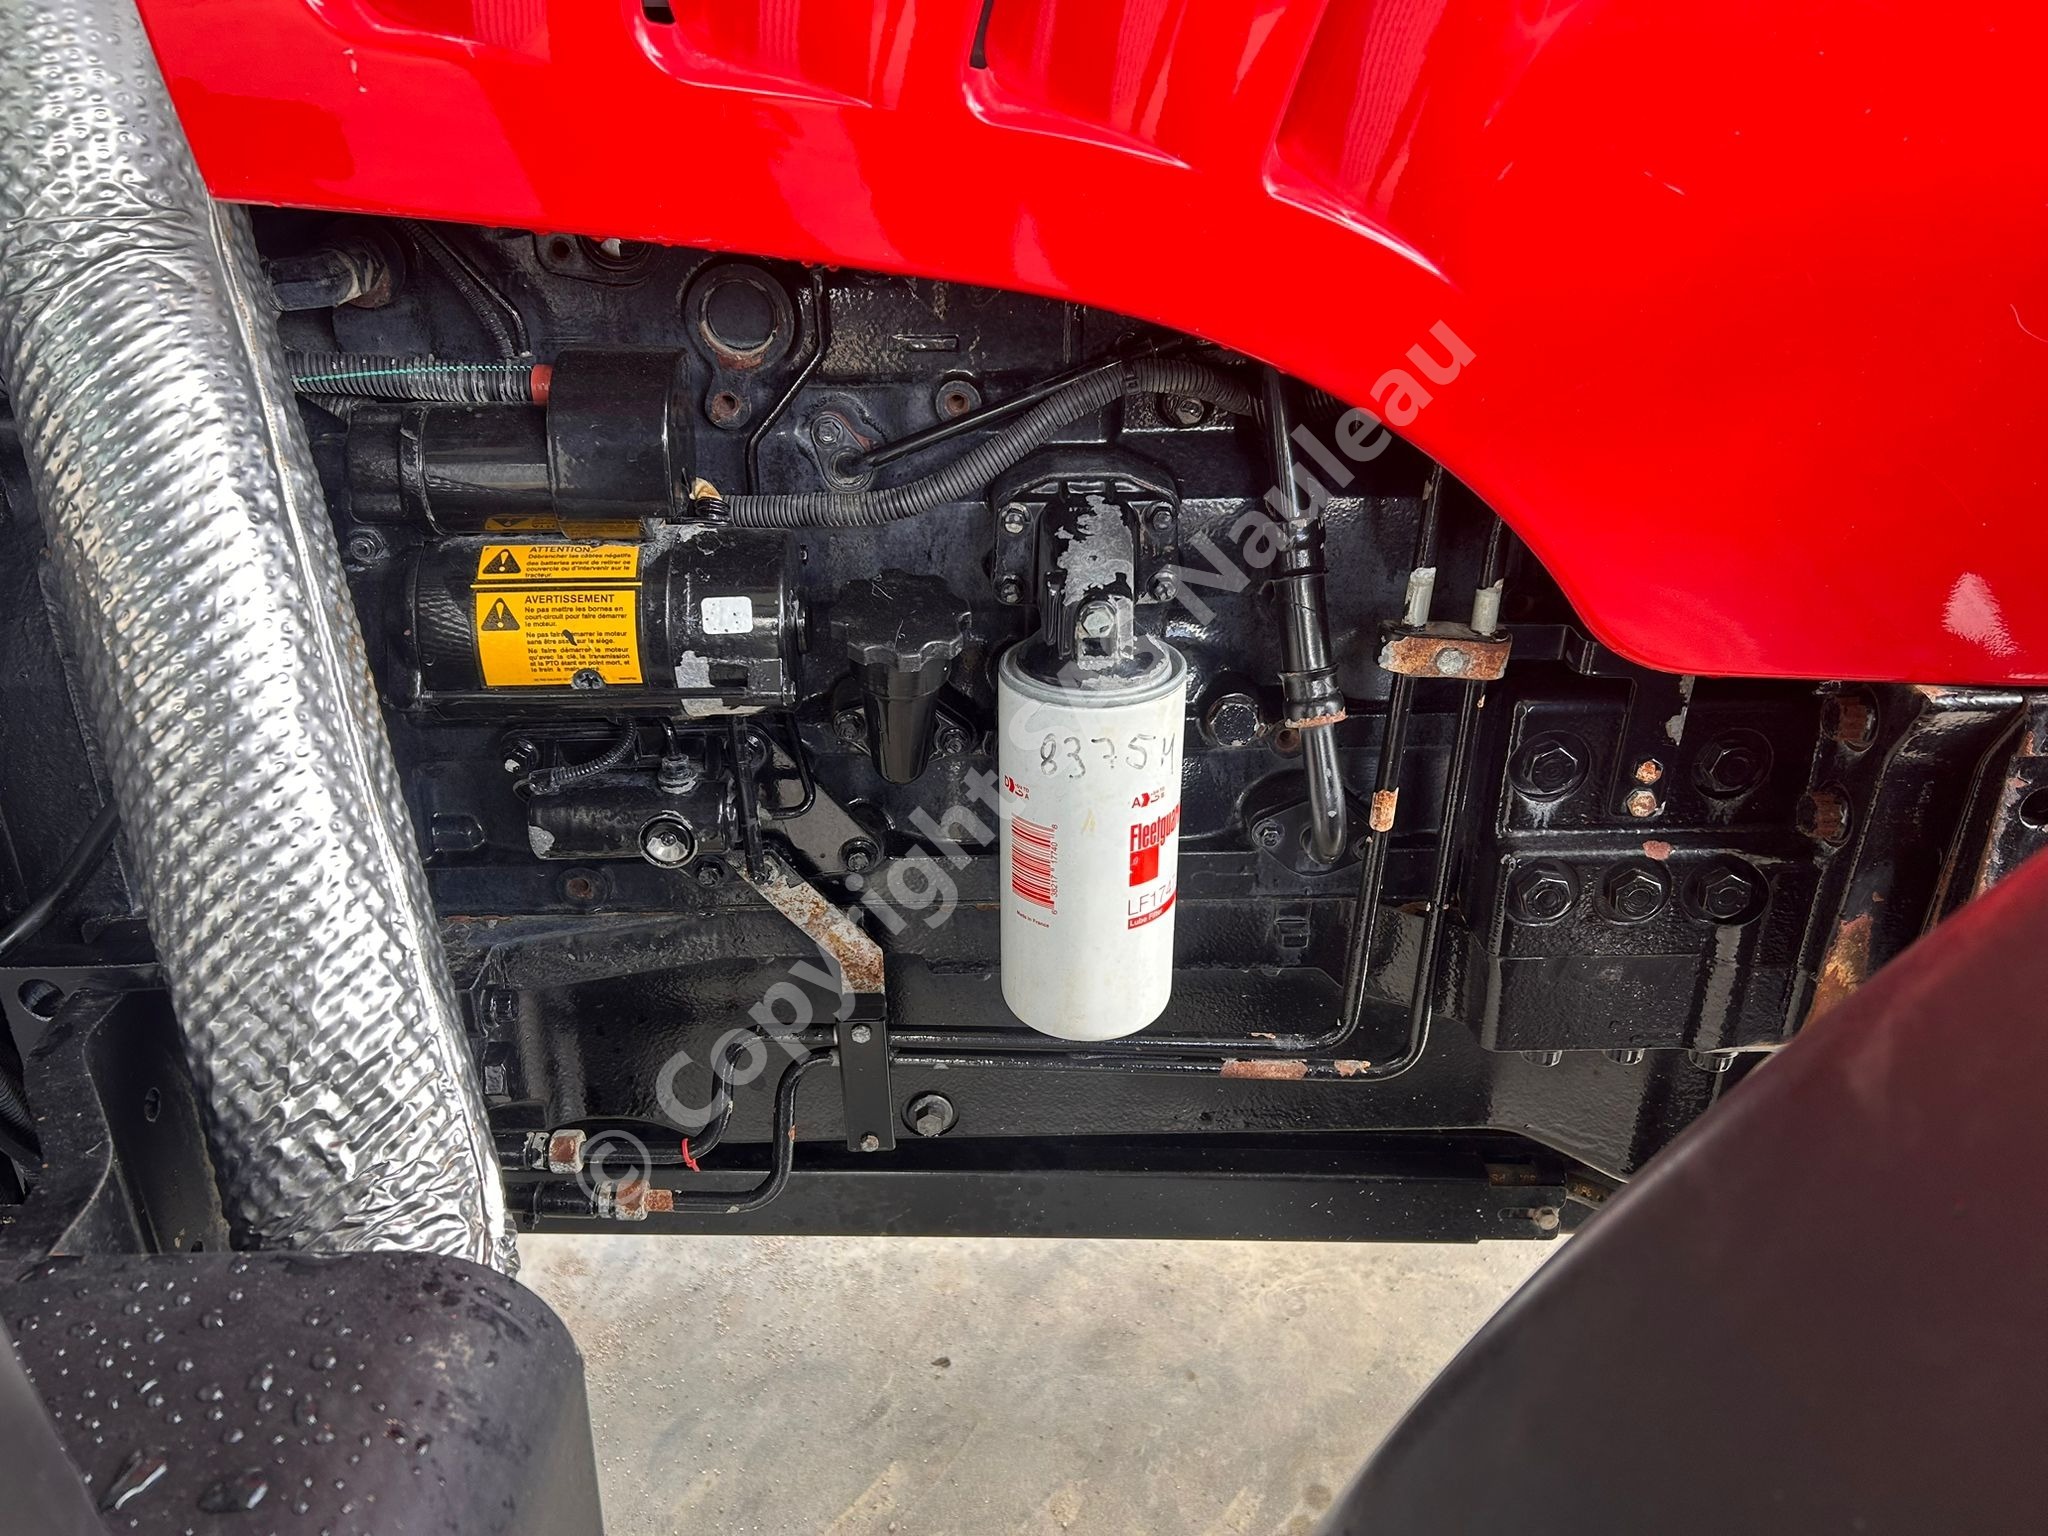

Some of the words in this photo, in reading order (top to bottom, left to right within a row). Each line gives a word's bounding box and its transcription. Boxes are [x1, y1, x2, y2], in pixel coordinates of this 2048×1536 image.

[525, 594, 614, 604] AVERTISSEMENT
[1131, 796, 1140, 808] A
[1033, 918, 1050, 928] France
[1129, 916, 1148, 927] Lube
